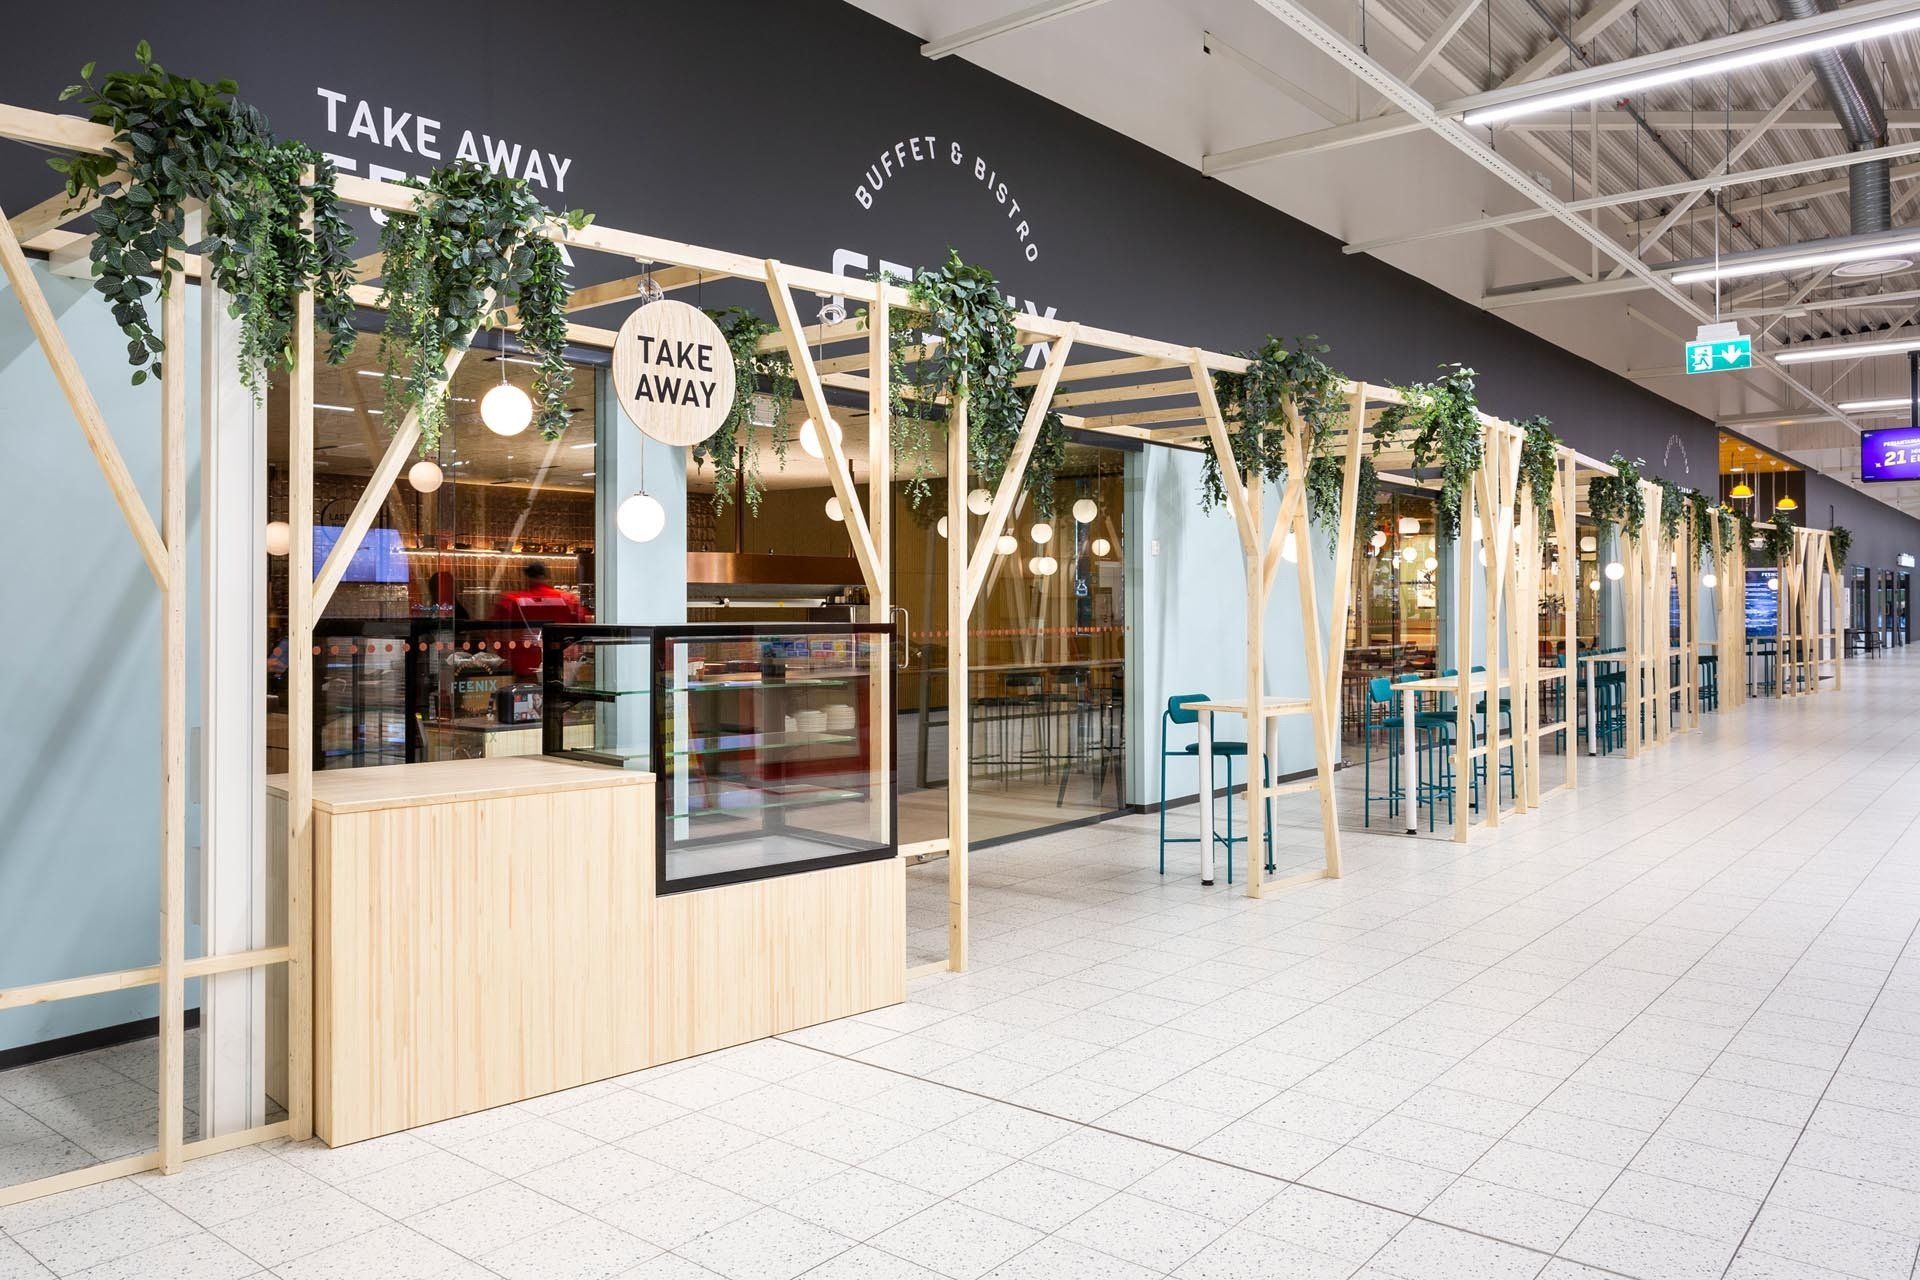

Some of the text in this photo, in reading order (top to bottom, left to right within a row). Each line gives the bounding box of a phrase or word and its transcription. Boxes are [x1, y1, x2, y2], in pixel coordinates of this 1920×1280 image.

[317, 87, 572, 192] TAKE AWAY
[855, 136, 1039, 262] BUFFET & BISTRO
[637, 335, 713, 372] TAKE
[634, 374, 717, 409] AWAY
[1884, 449, 1907, 466] 21
[451, 680, 497, 694] FEENIX
